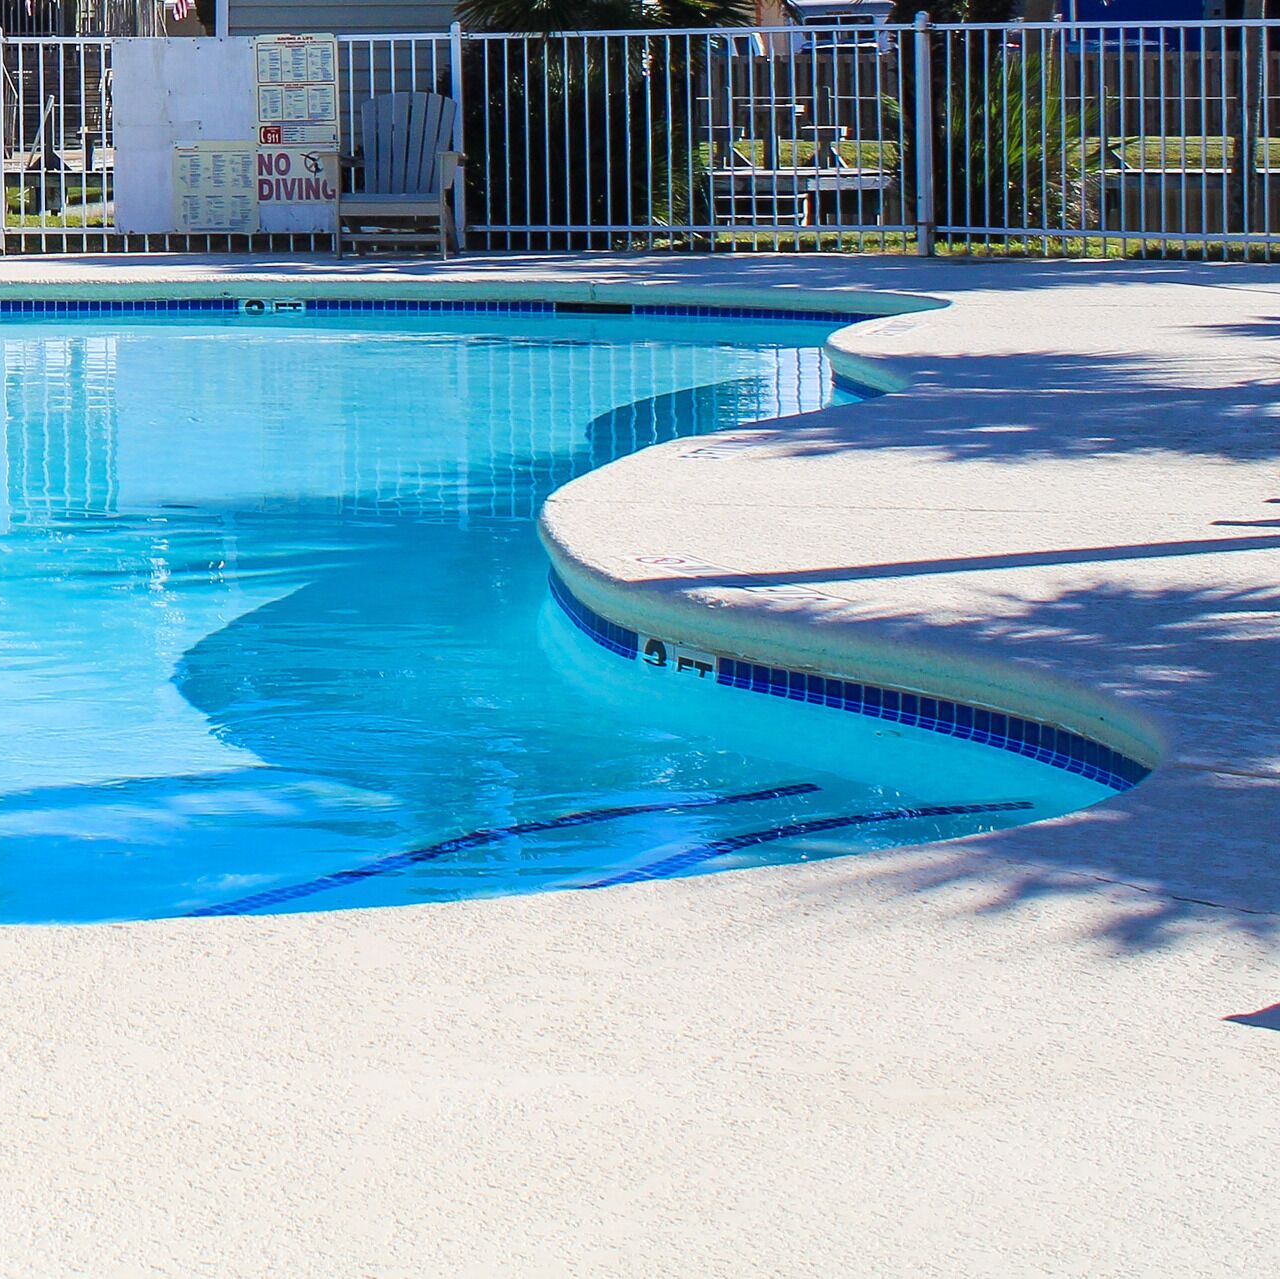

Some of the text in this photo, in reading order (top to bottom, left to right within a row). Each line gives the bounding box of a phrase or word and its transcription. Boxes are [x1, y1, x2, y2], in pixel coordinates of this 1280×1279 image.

[267, 133, 279, 143] 911
[257, 153, 291, 176] NO
[258, 177, 336, 201] DIVING
[677, 656, 713, 678] FT
